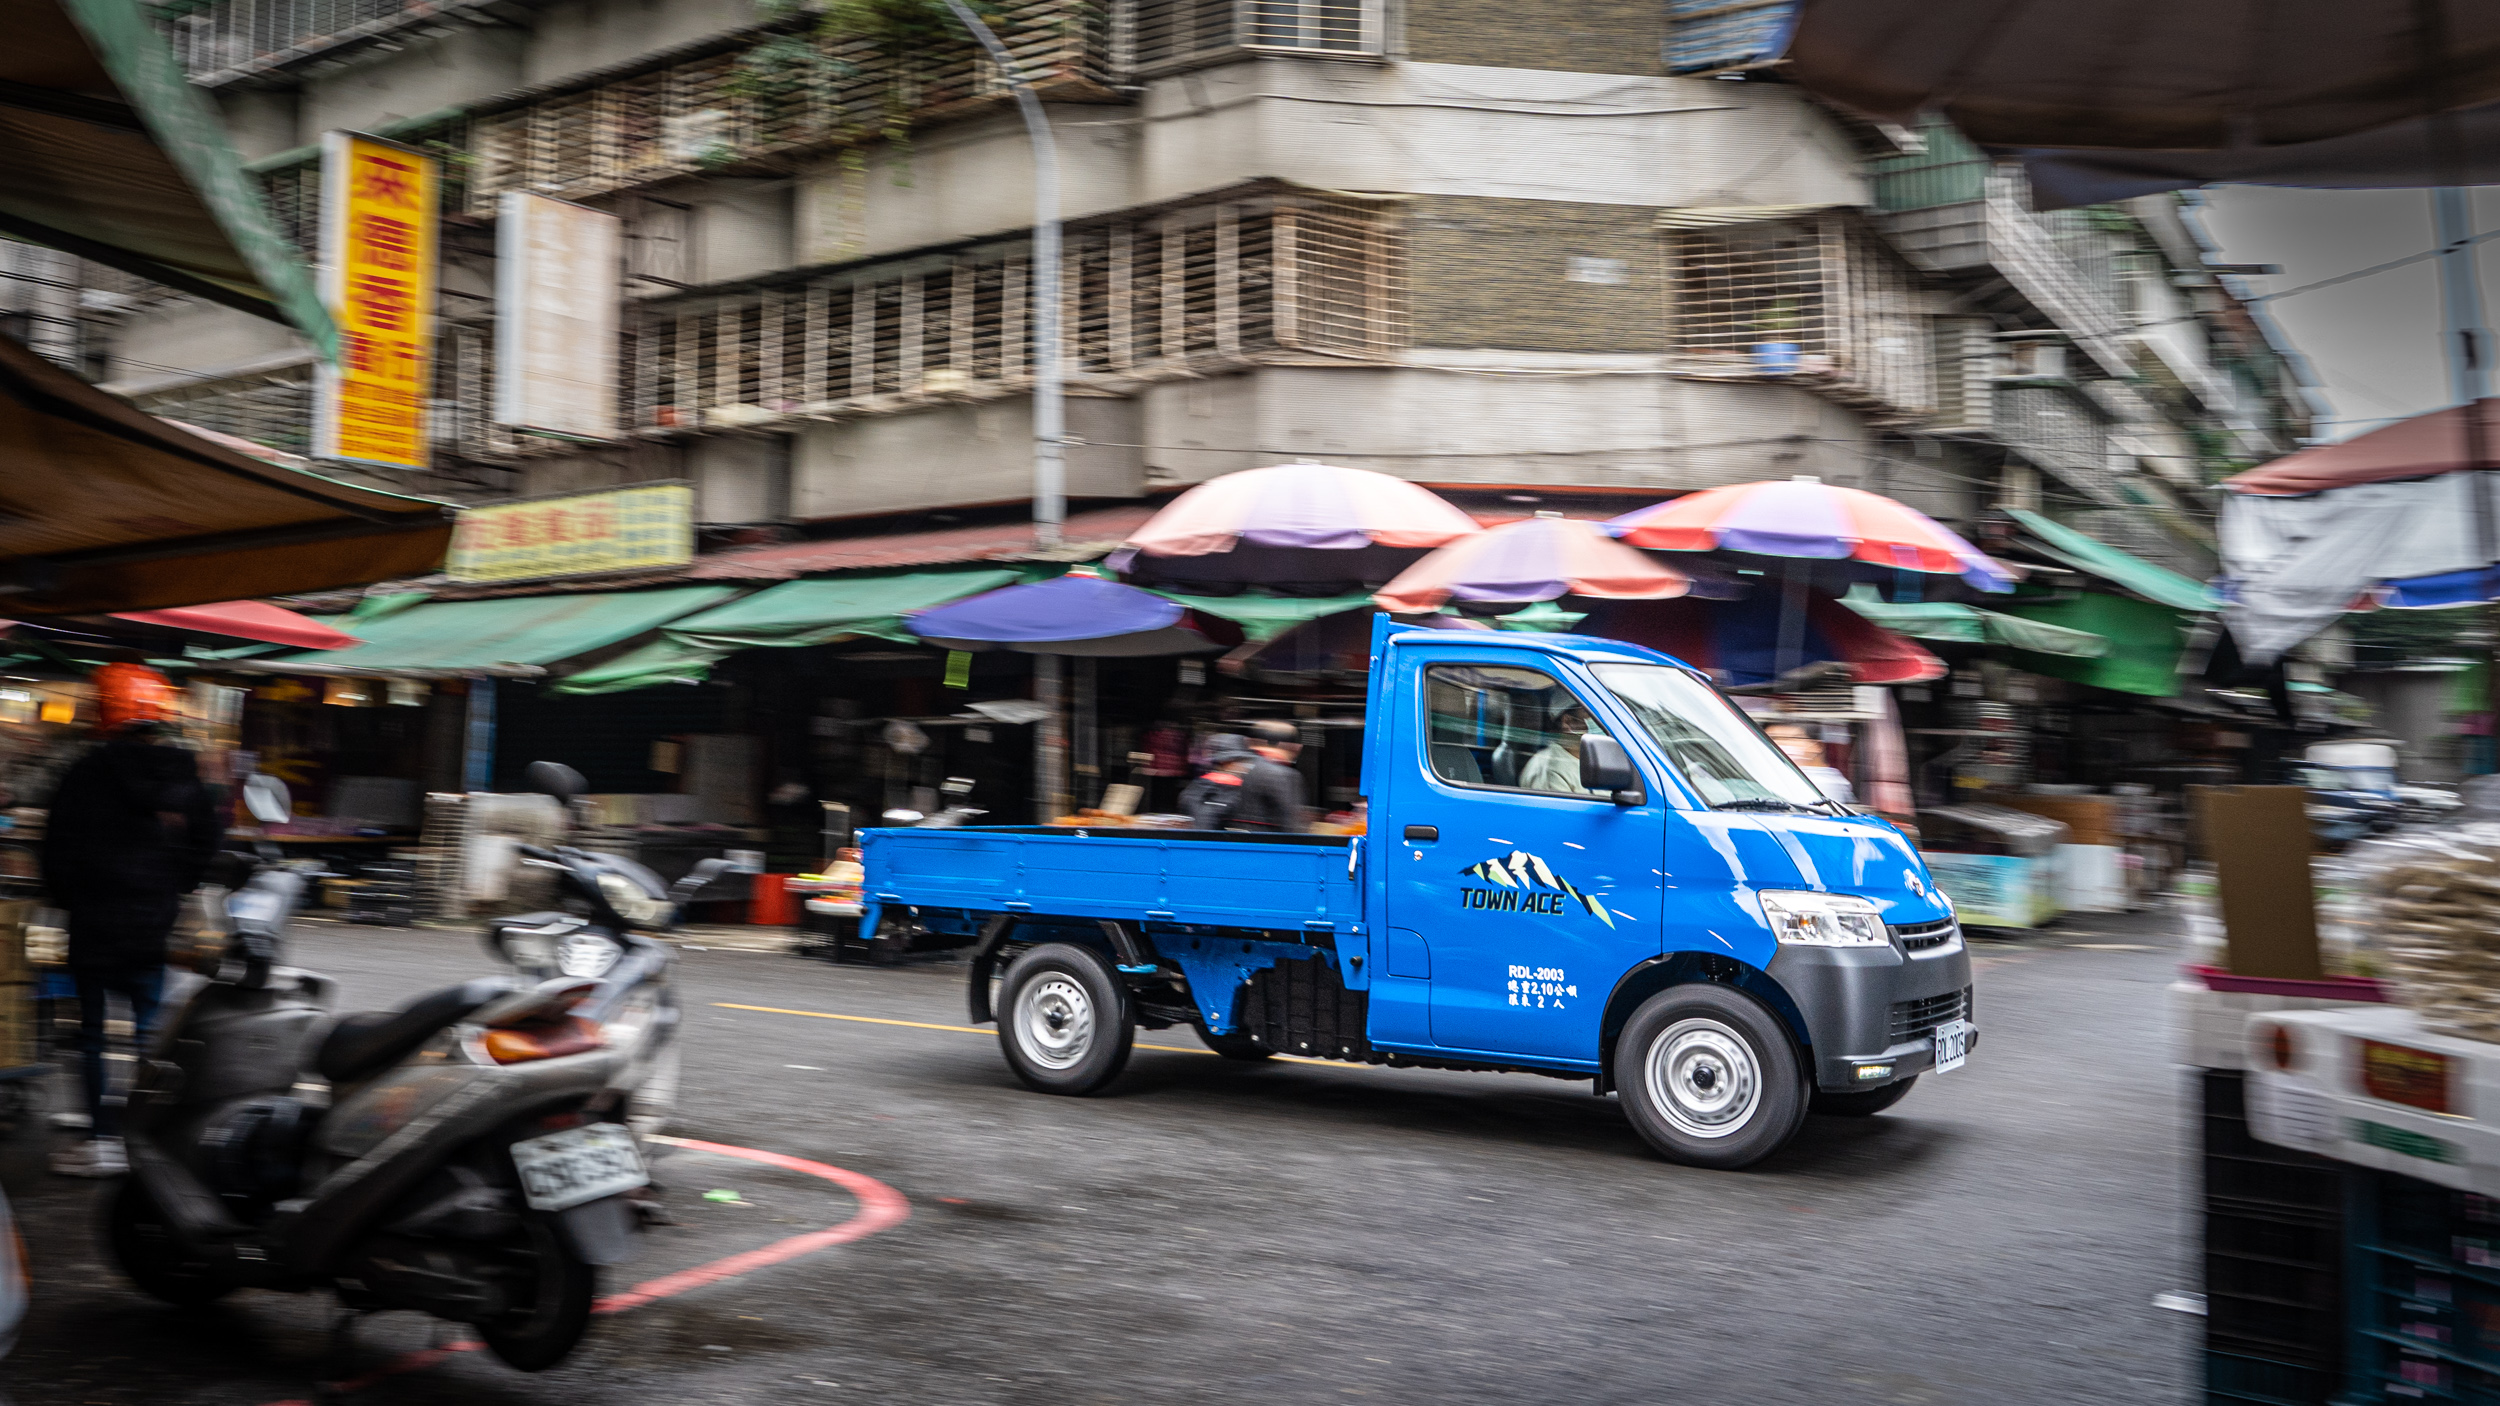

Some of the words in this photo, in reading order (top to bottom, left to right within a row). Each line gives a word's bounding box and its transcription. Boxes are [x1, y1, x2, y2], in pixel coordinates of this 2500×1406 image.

[1460, 887, 1519, 912] TOWN
[1520, 891, 1566, 916] ACE
[1508, 964, 1564, 982] RDL-2003
